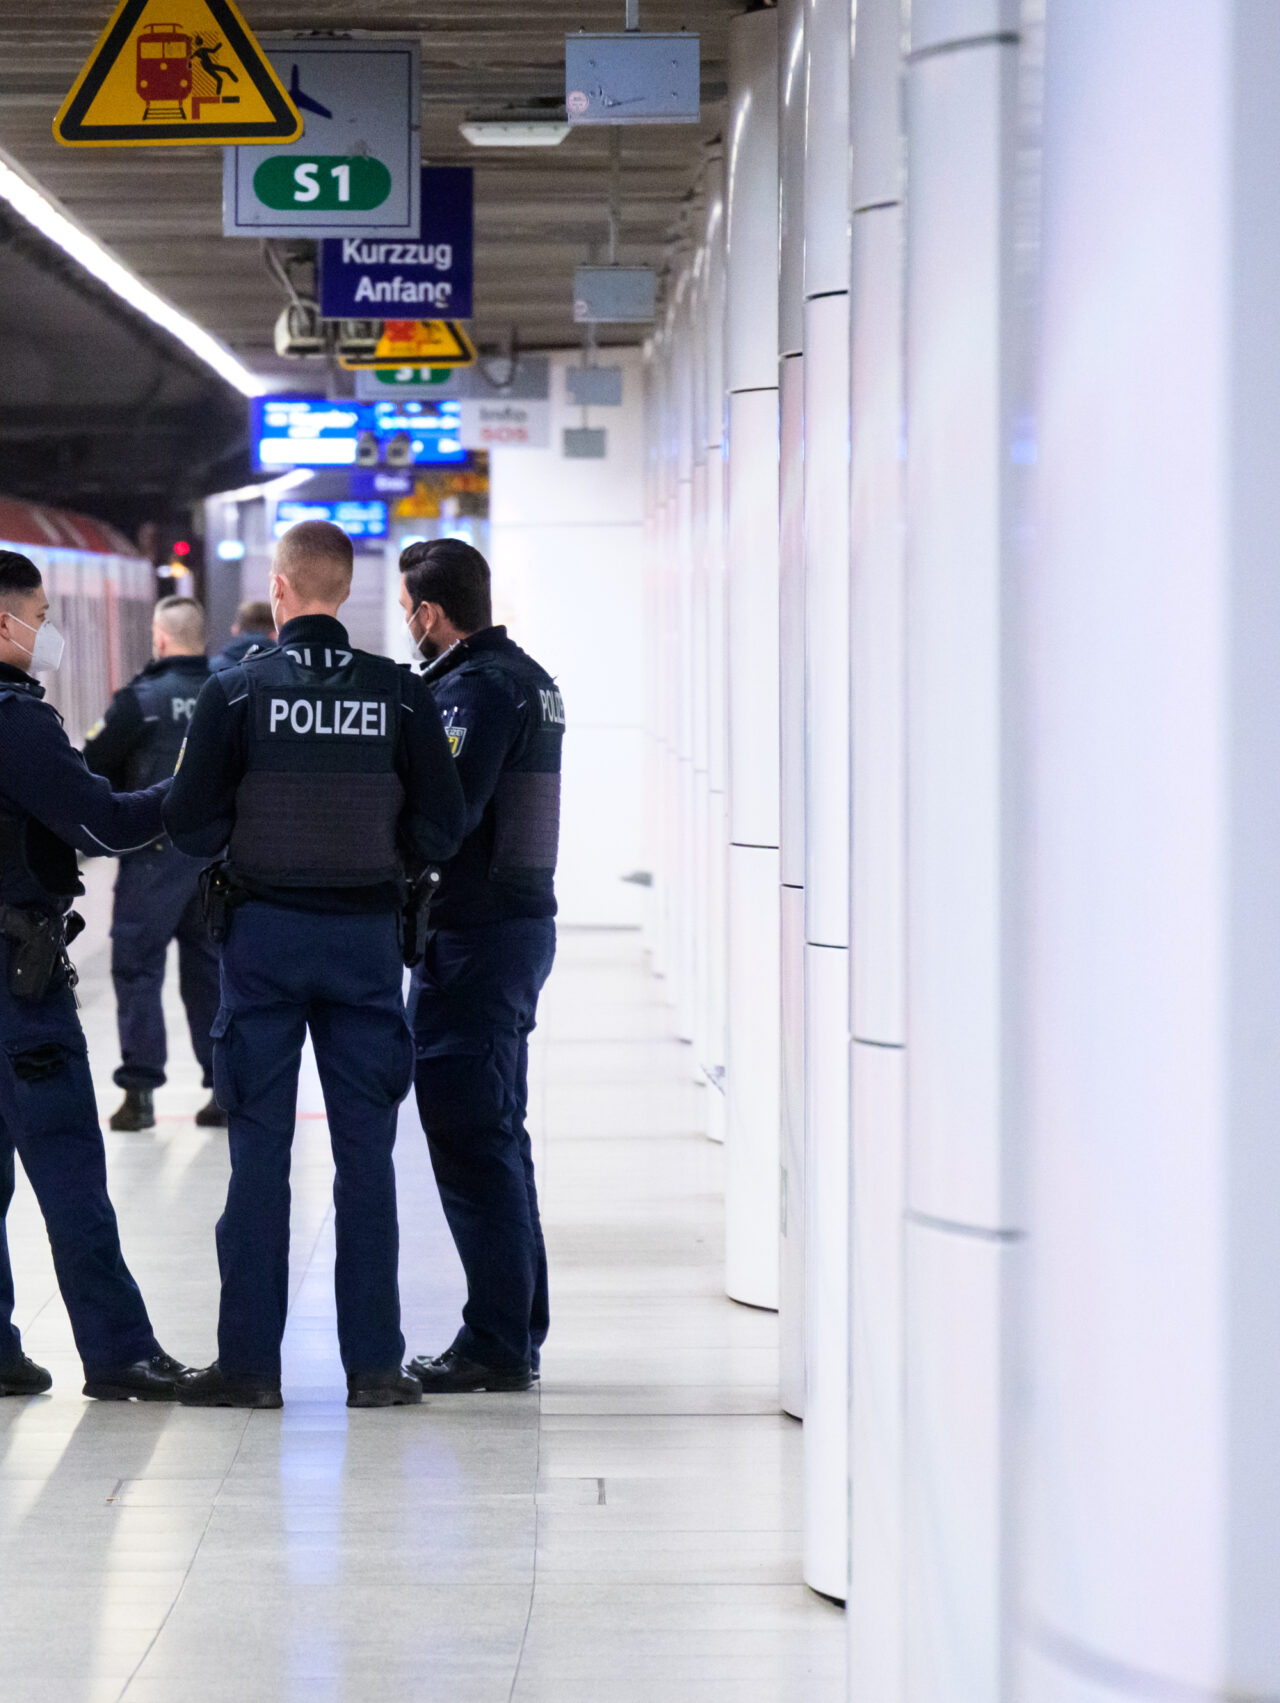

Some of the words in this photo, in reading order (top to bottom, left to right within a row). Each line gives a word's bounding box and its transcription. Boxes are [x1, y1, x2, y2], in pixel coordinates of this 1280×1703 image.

[342, 238, 453, 270] Kurzzug
[354, 276, 452, 308] Anfang
[269, 698, 386, 736] POLIZEI
